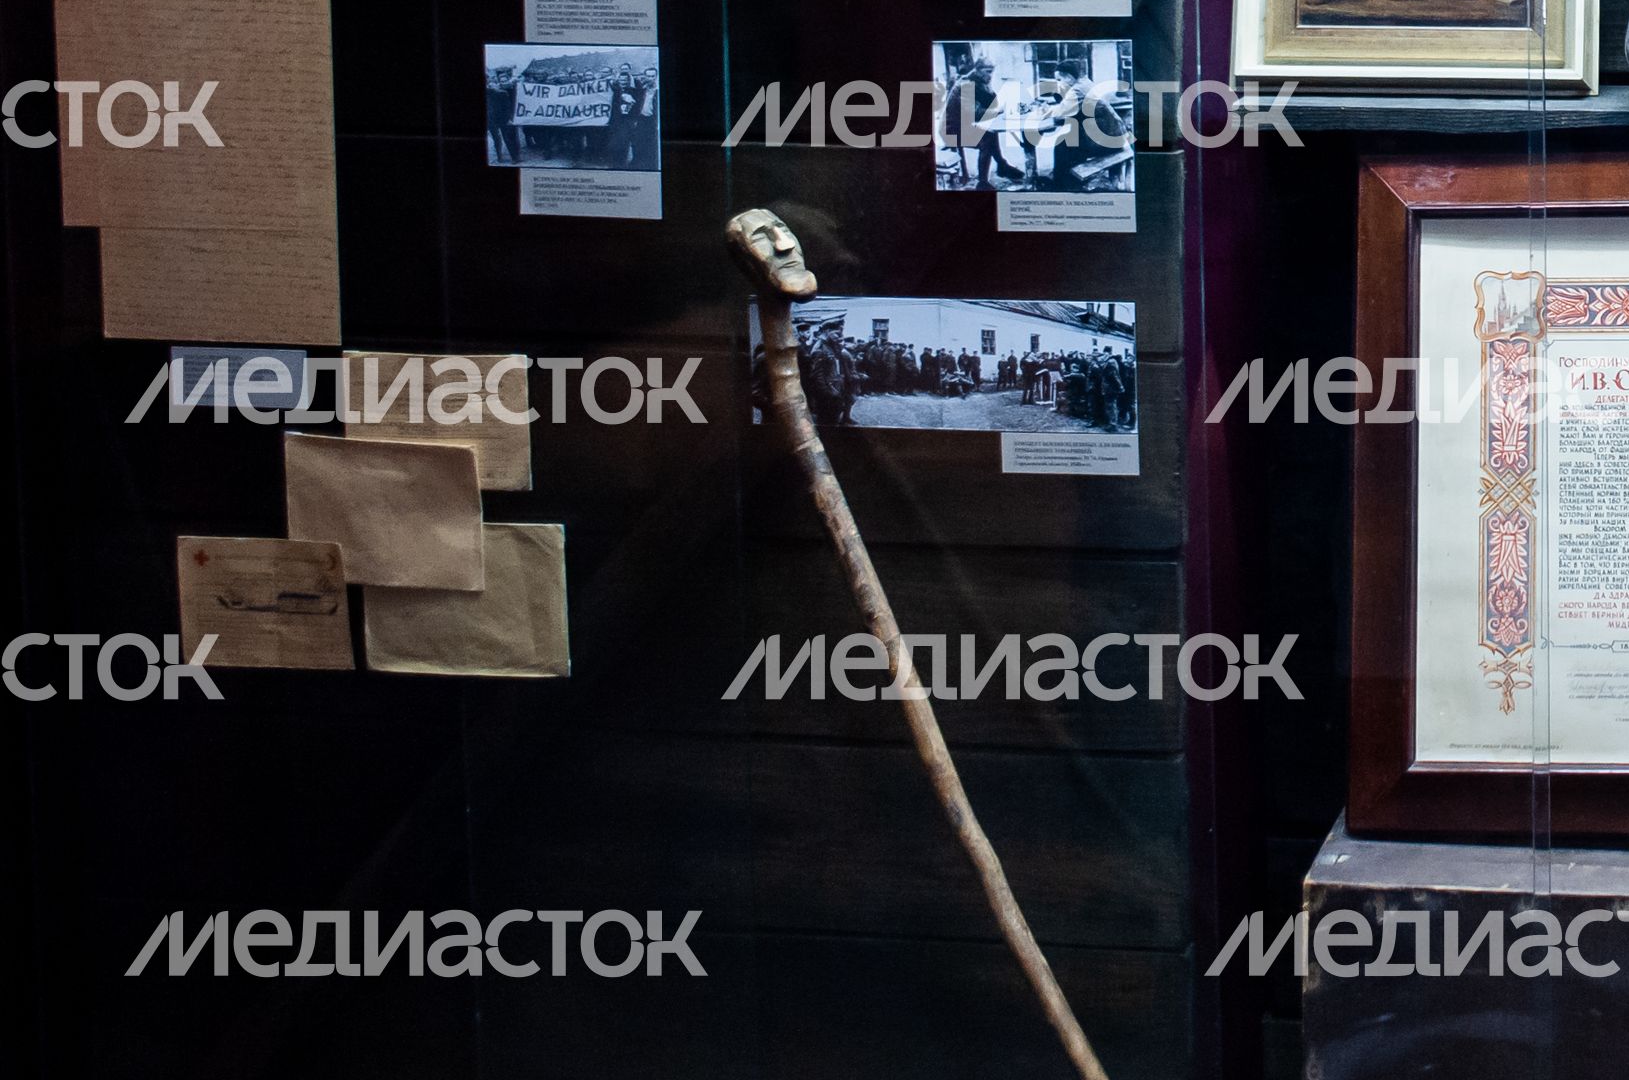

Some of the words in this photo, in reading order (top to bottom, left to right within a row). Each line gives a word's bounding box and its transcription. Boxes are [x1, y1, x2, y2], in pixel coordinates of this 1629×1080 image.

[523, 84, 551, 99] WIR
[534, 104, 611, 119] ADENAUER
[1587, 601, 1618, 610] НАРОДА
